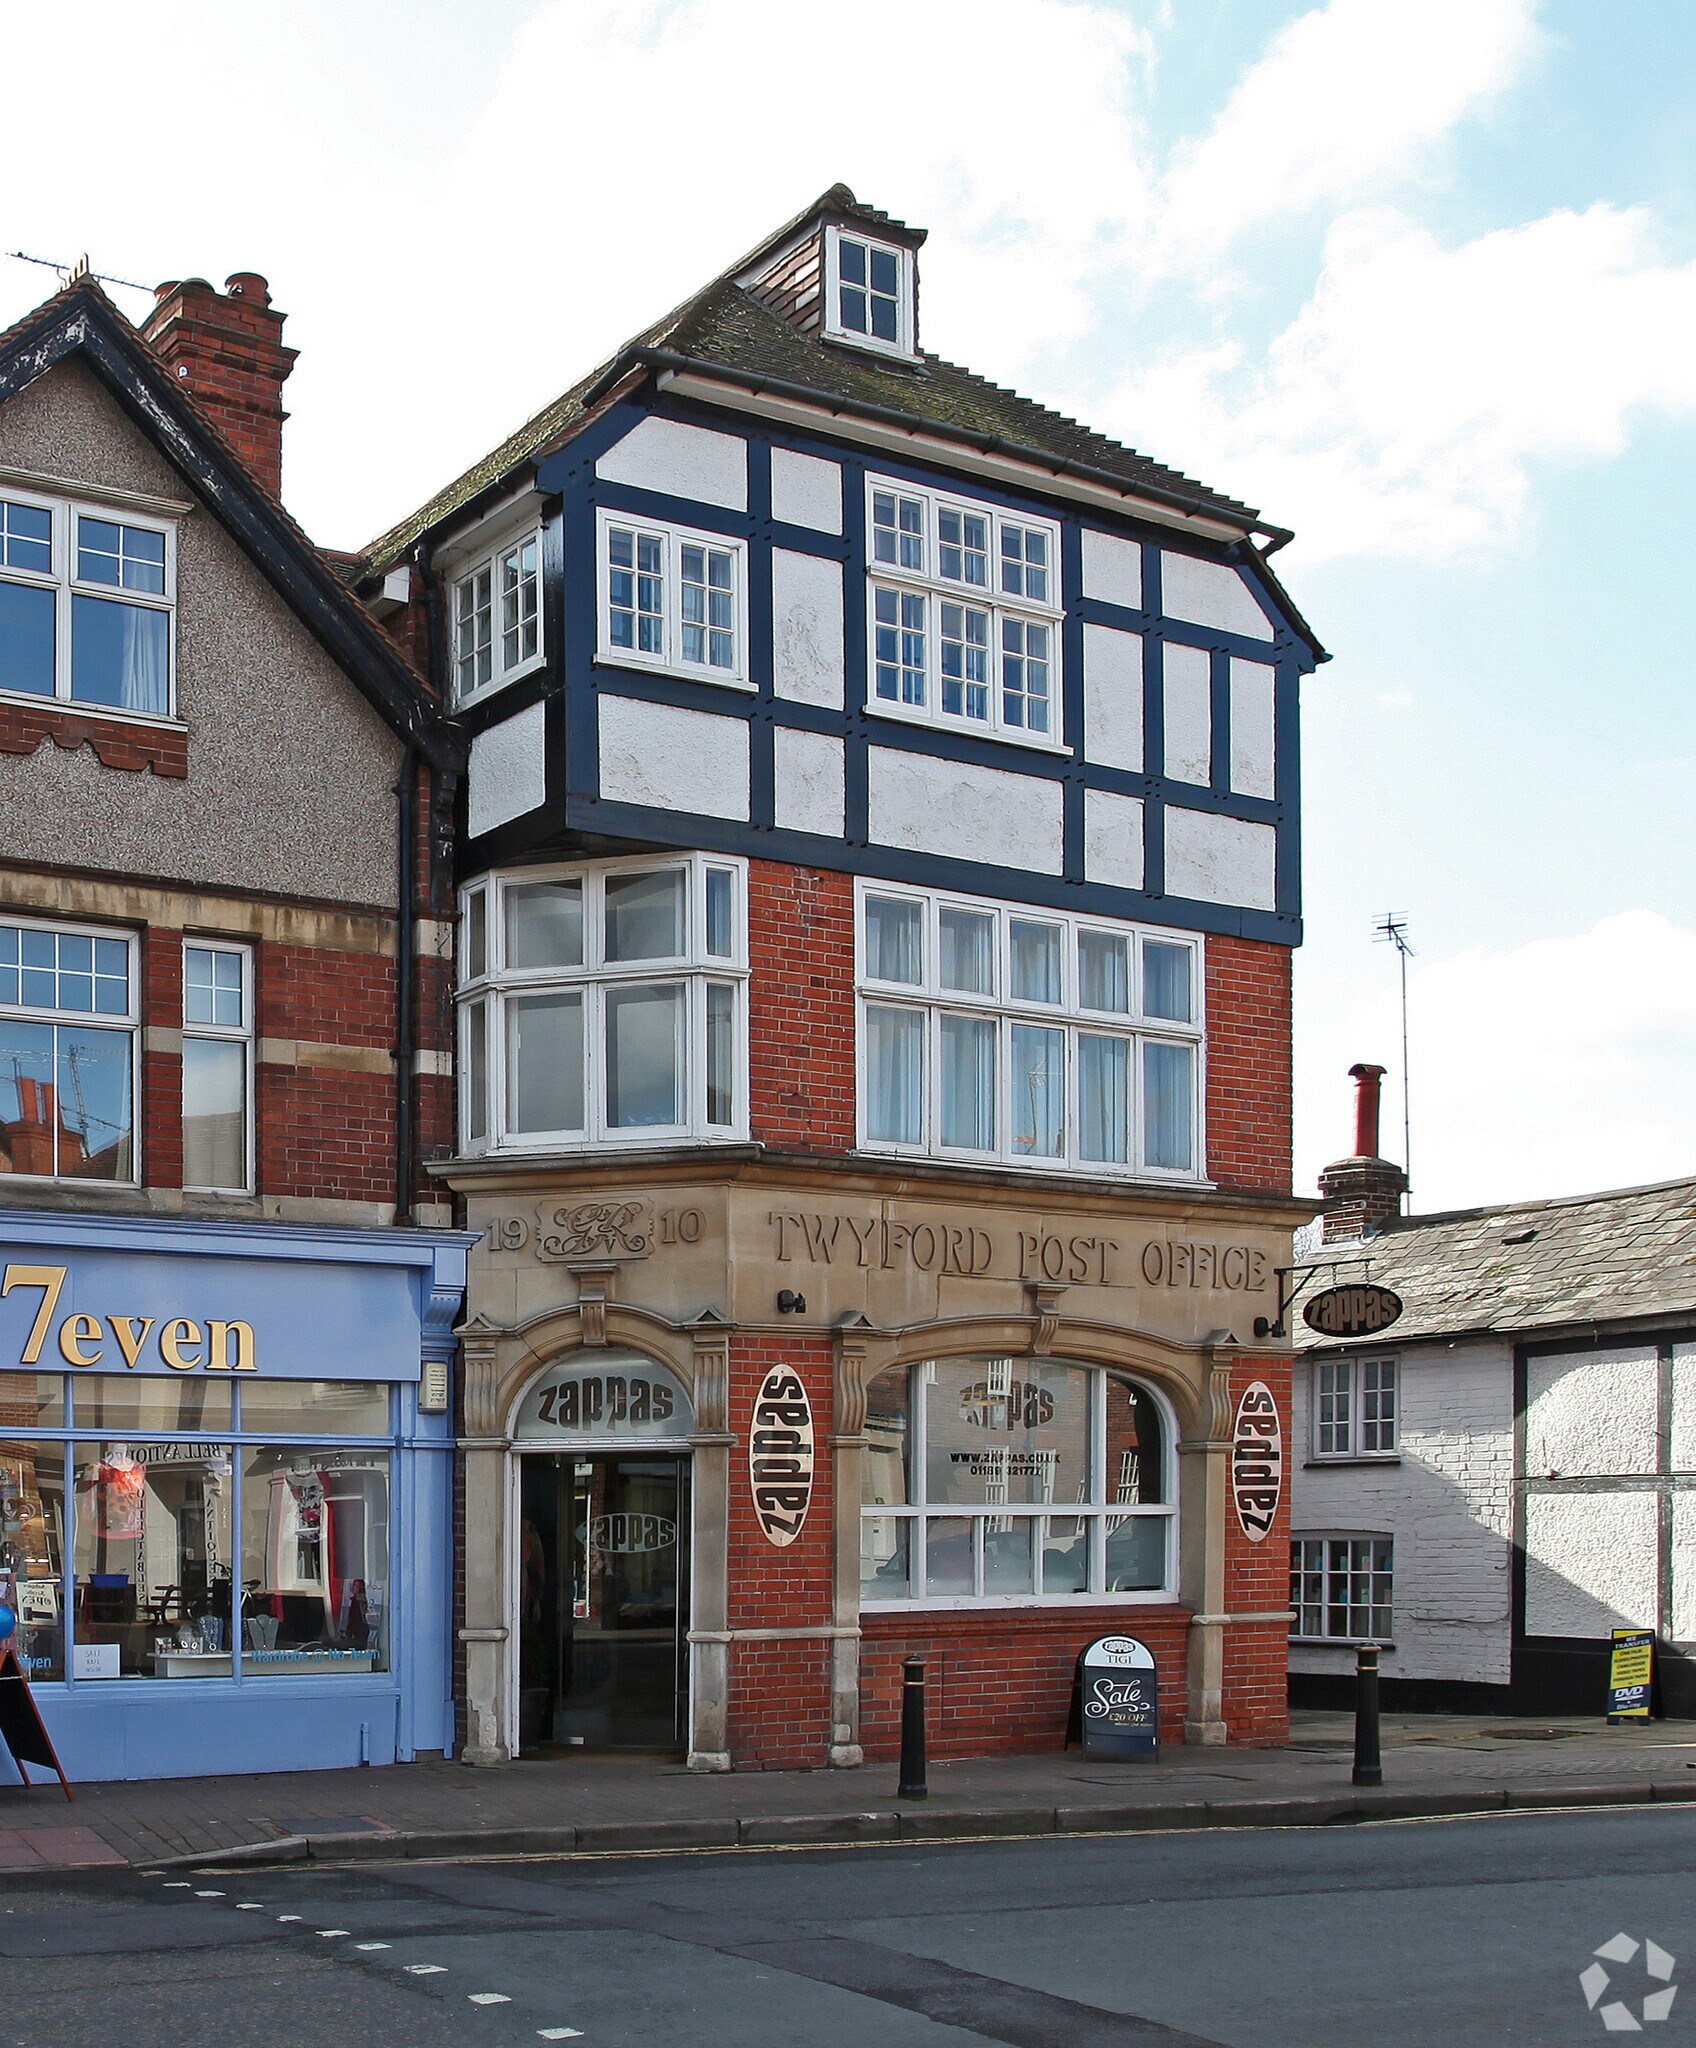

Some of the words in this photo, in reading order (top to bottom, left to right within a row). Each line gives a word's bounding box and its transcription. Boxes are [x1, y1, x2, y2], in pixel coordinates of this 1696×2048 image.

[487, 1216, 529, 1251] 19
[661, 1208, 707, 1244] 10
[769, 1211, 993, 1274] TWYFORD
[1019, 1230, 1119, 1284] POST
[1142, 1239, 1267, 1292] OFFICE
[1, 1264, 259, 1372] 7even
[1309, 1289, 1398, 1331] zappas
[539, 1375, 675, 1430] zappas
[752, 1374, 811, 1537] zappas
[1234, 1390, 1280, 1533] zappas
[252, 1650, 308, 1662] Wardrobe
[329, 1649, 344, 1660] No
[1106, 1655, 1132, 1664] TIGI
[1615, 1639, 1650, 1649] TRANSFER
[1085, 1678, 1144, 1718] Sale
[1614, 1686, 1644, 1698] DVD
[1109, 1713, 1126, 1721] £20
[1128, 1713, 1147, 1721] OFF
